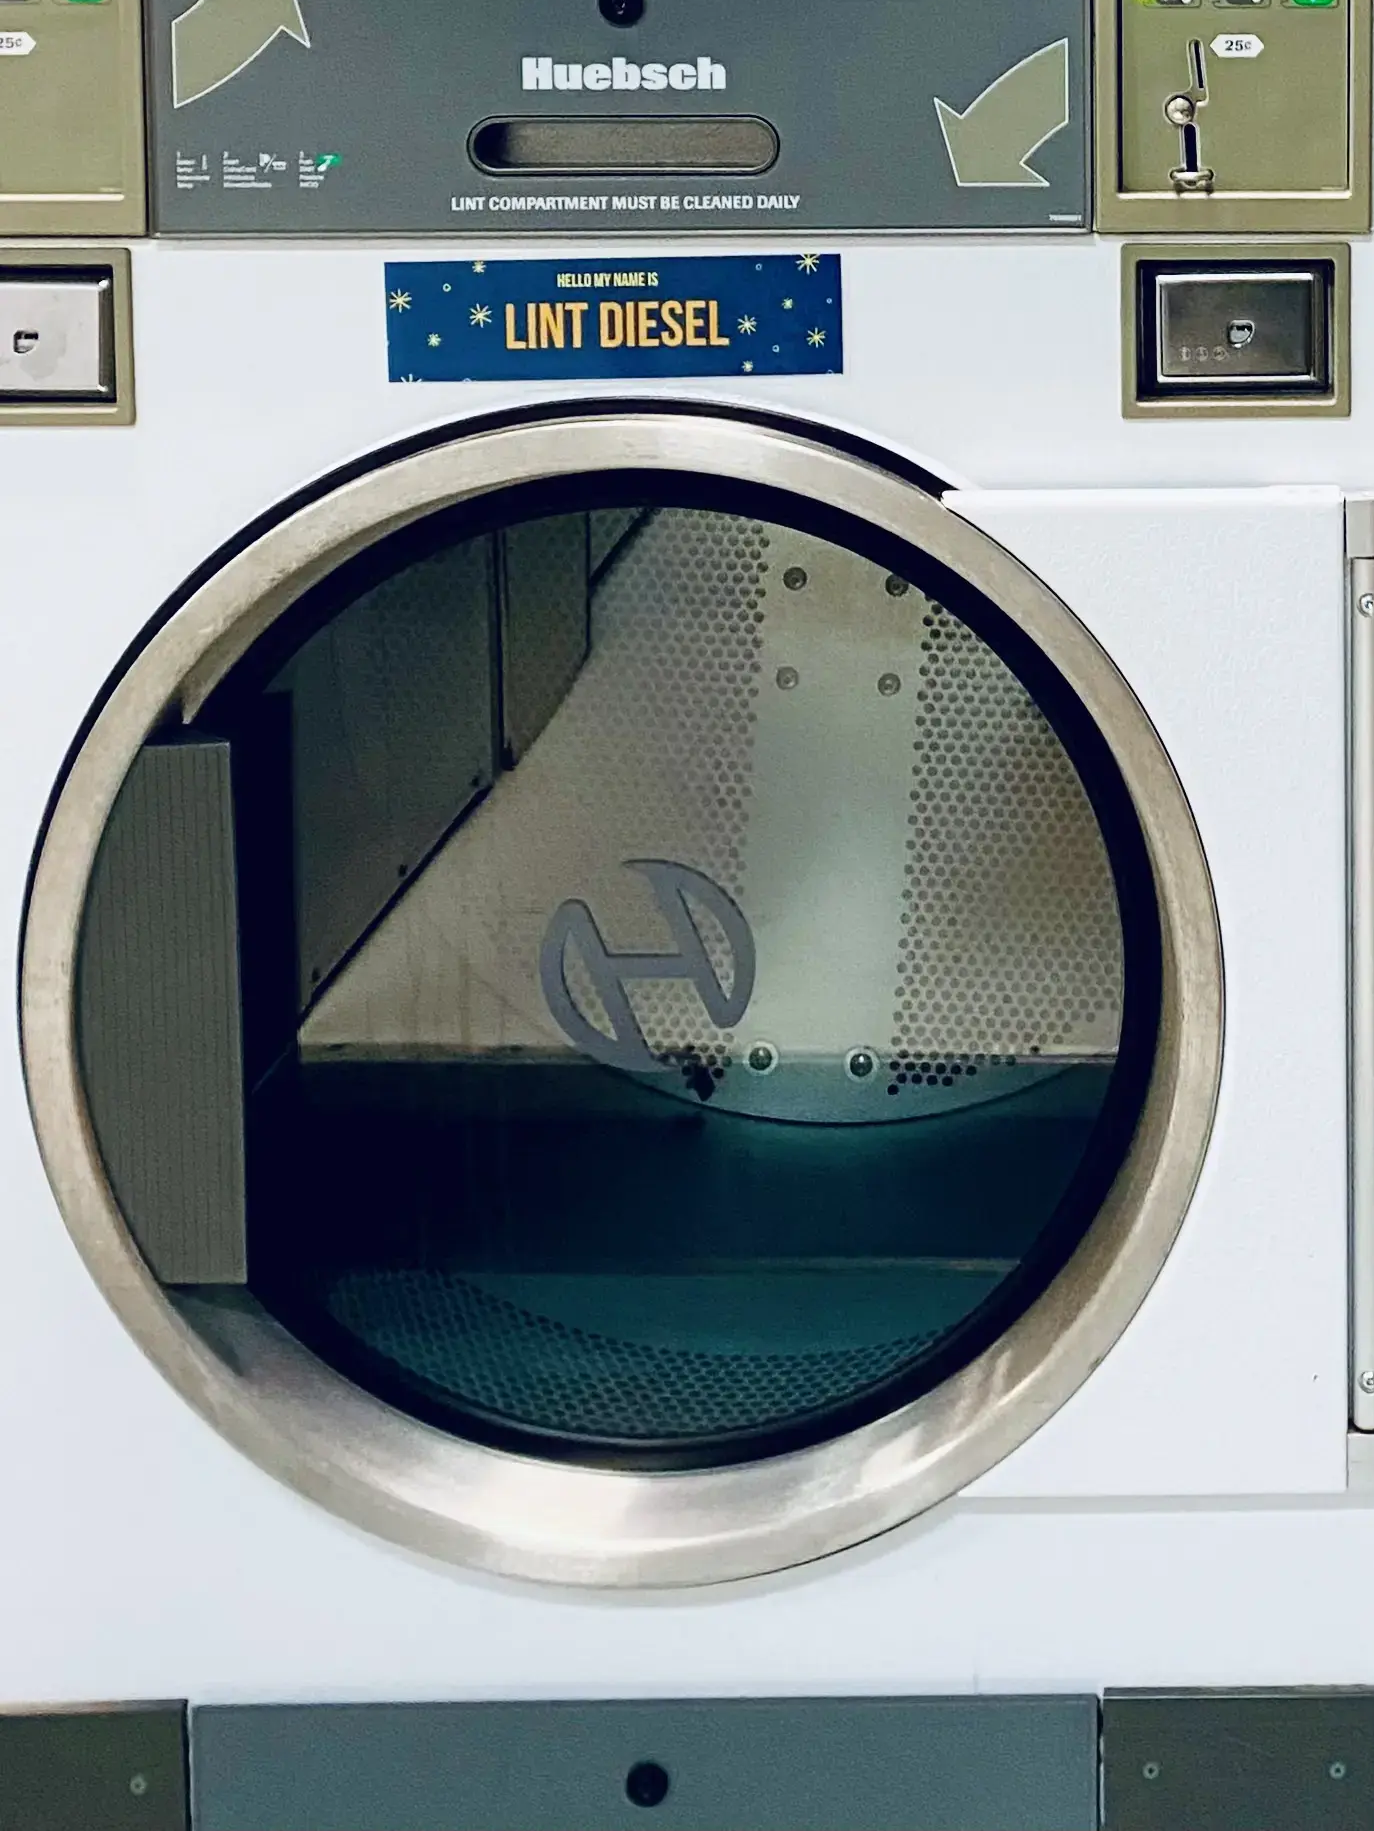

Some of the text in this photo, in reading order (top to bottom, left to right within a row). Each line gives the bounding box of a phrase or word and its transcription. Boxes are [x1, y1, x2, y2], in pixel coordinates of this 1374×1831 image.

[522, 56, 727, 91] Huebsch
[451, 194, 800, 212] LINT COMPARTMENT MUST BE CLEANED DAILY
[557, 271, 659, 288] HELLO MY NAME IS
[505, 299, 730, 351] LINT DIESEL
